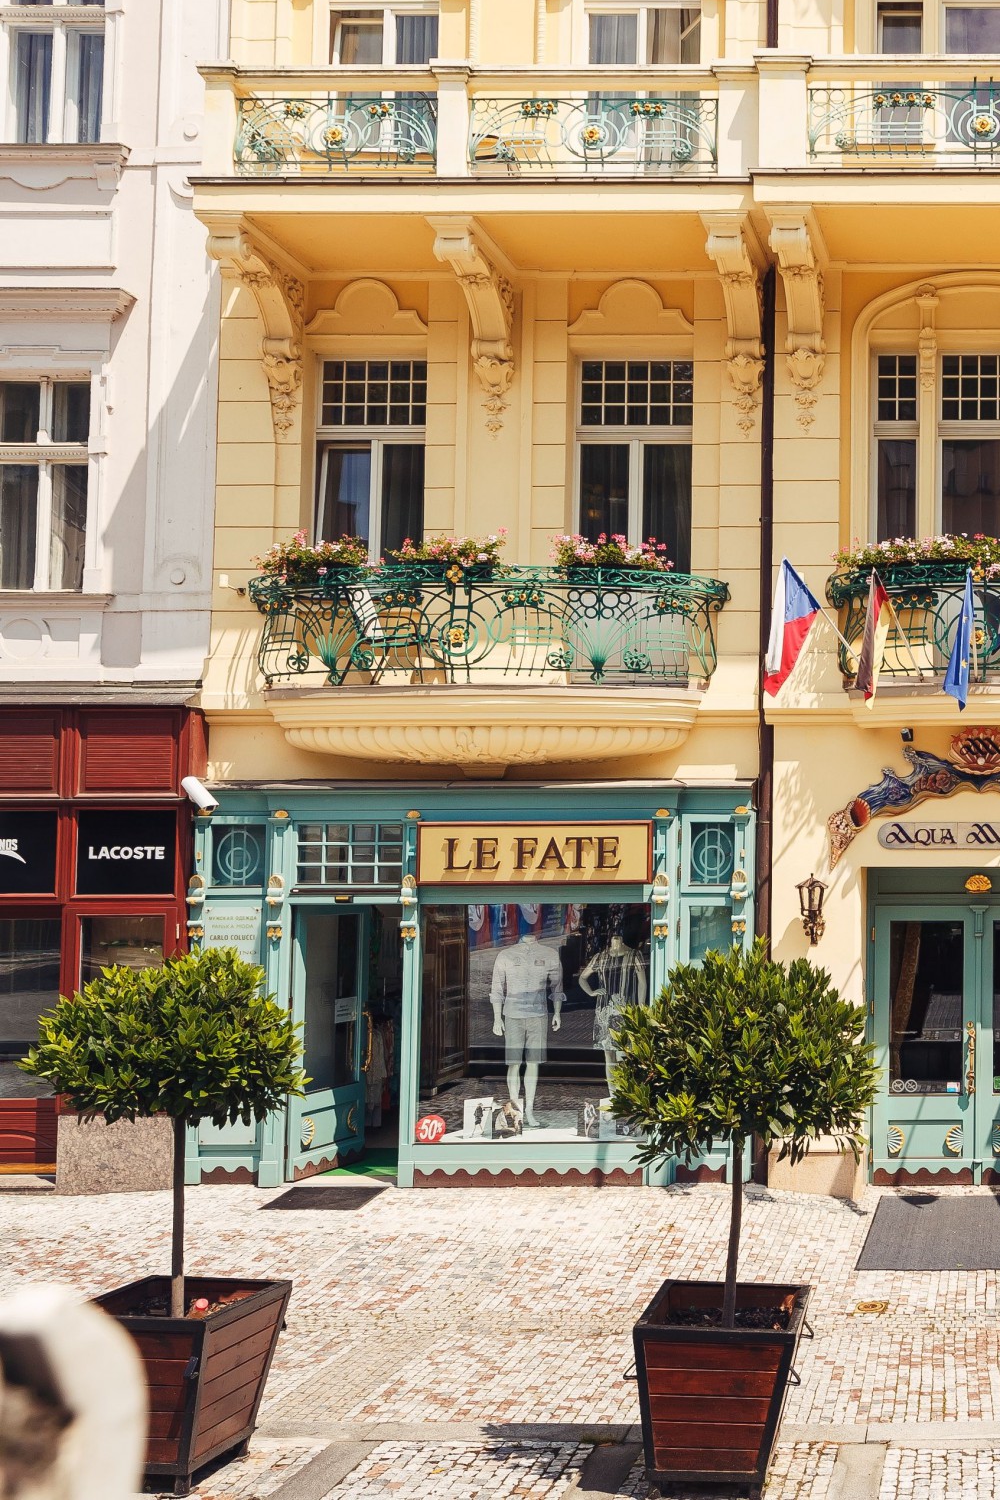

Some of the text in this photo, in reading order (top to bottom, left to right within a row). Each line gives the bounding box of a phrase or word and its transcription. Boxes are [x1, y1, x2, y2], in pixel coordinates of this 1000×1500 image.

[885, 823, 957, 846] AQUA
[88, 846, 165, 860] LACOSTE
[443, 836, 622, 870] LE FATE
[418, 1118, 443, 1140] -50%
